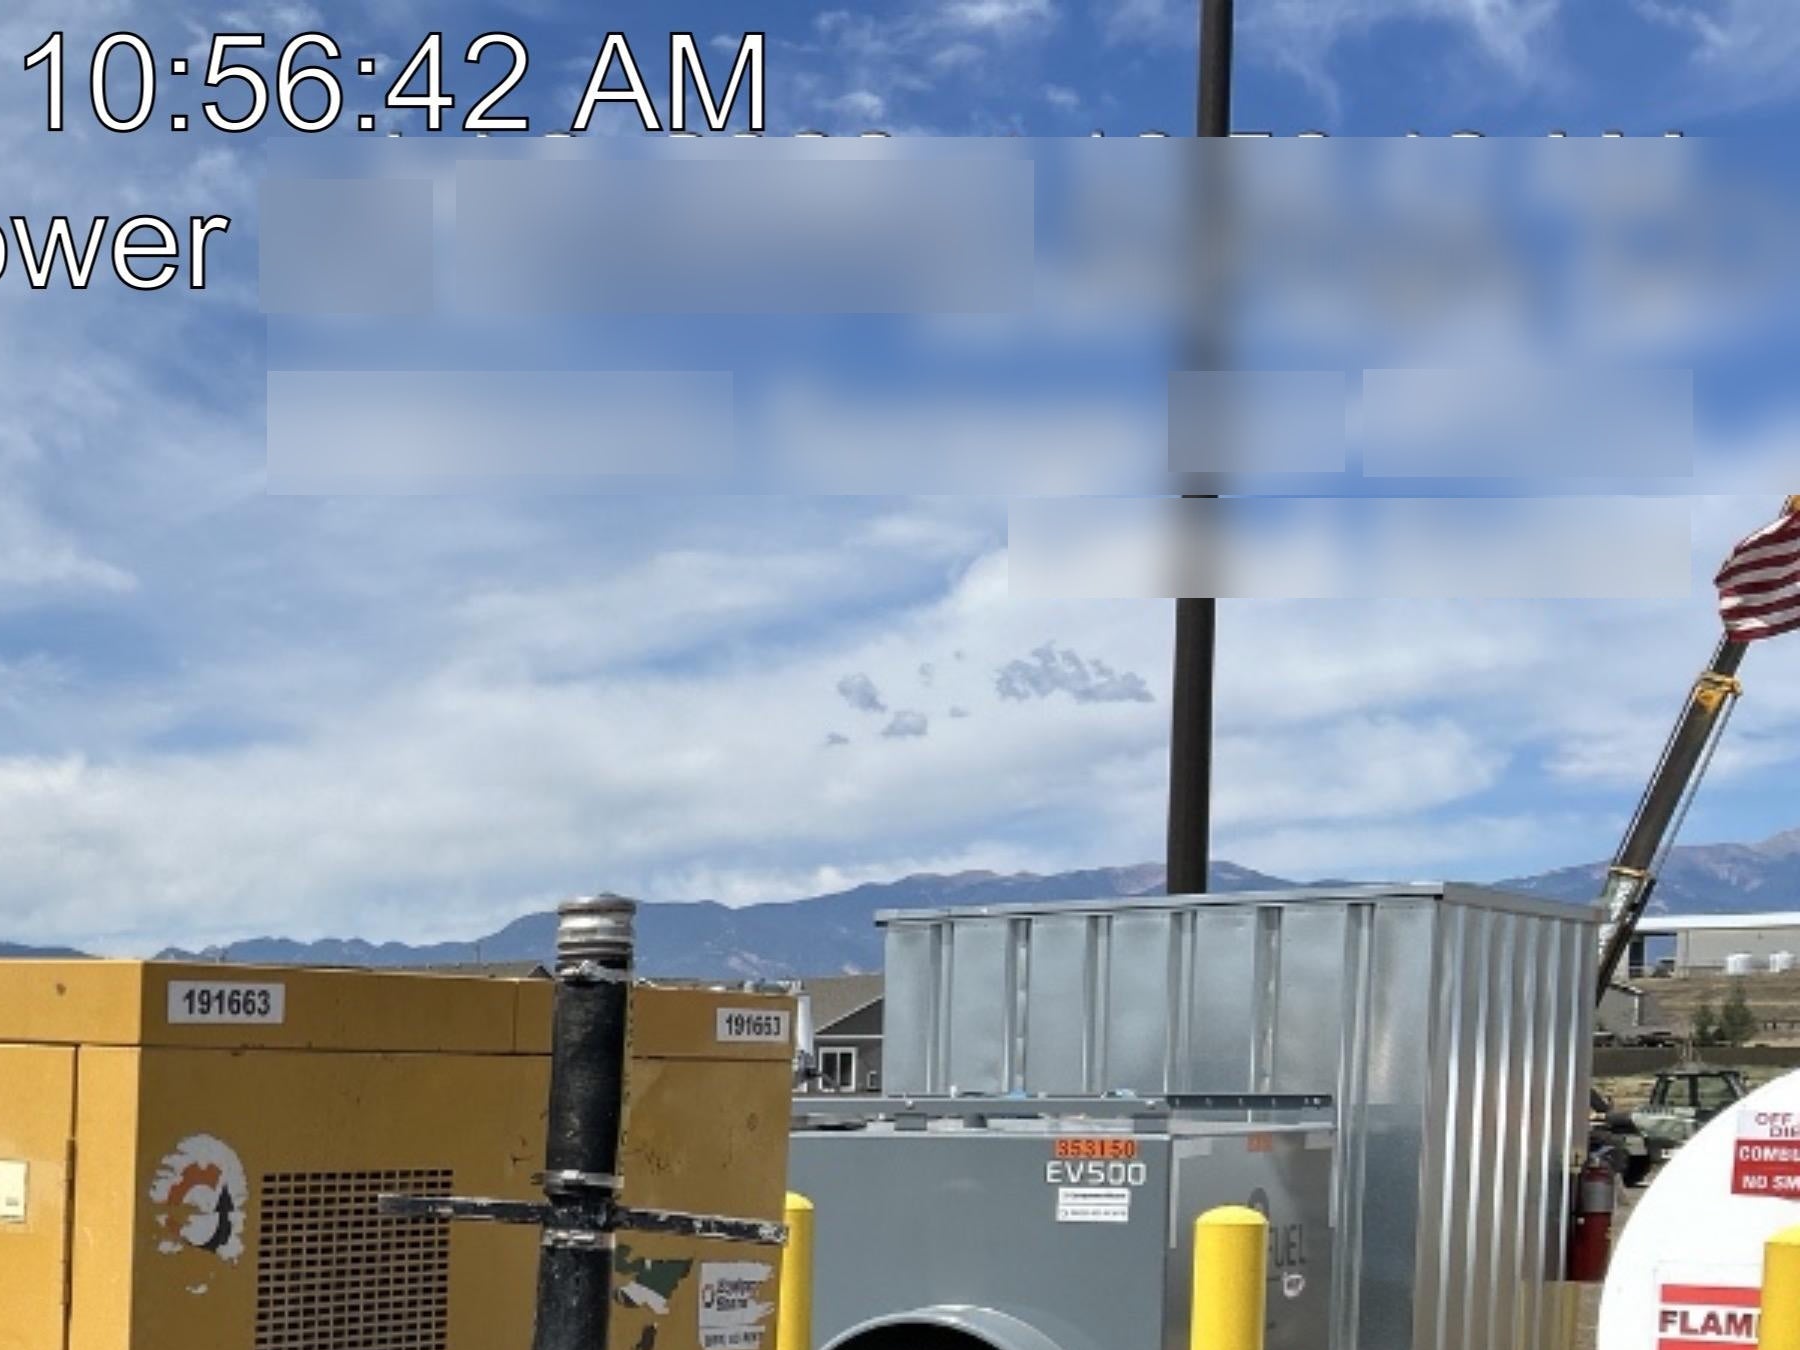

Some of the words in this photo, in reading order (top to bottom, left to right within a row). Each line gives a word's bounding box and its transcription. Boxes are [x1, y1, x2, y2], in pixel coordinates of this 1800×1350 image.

[183, 989, 271, 1016] 191663
[1755, 1112, 1794, 1126] OFF
[1046, 1160, 1146, 1186] EV500
[1742, 1175, 1768, 1190] NO
[1269, 1223, 1307, 1268] UEL
